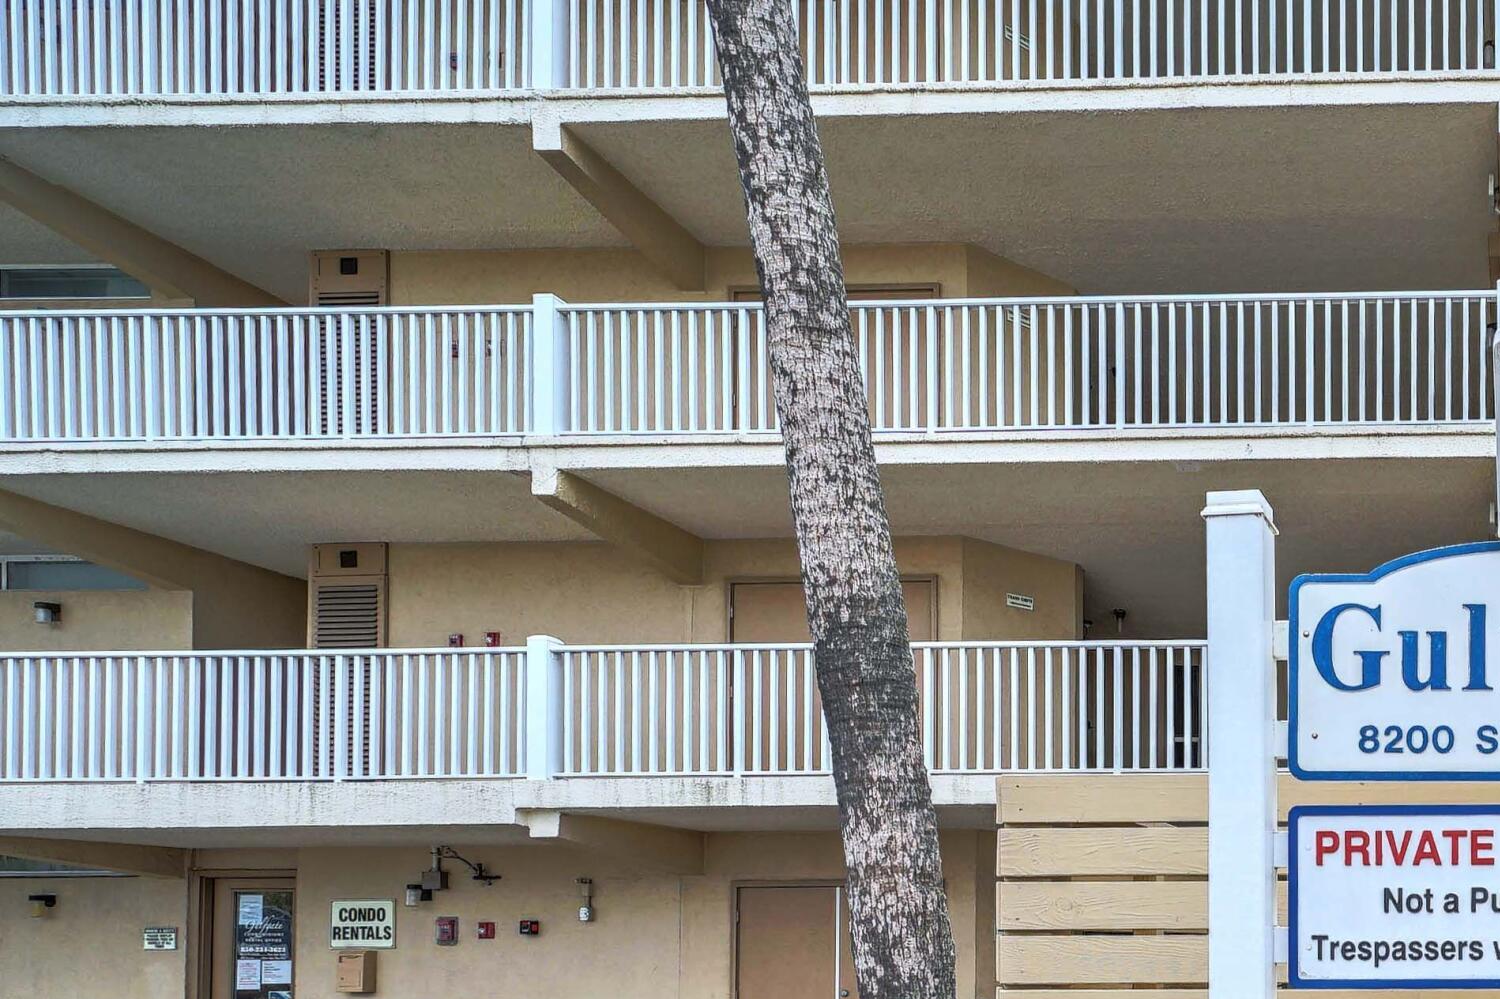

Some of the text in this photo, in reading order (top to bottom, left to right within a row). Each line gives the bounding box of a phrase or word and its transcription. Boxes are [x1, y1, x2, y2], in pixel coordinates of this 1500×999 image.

[1359, 725, 1454, 754] 8200
[1316, 830, 1494, 866] PRIVATE
[339, 907, 386, 922] CONDO
[1384, 888, 1433, 914] Not
[1443, 893, 1459, 913] a
[332, 926, 392, 940] RENTALS
[1311, 935, 1483, 968] Trespassers
